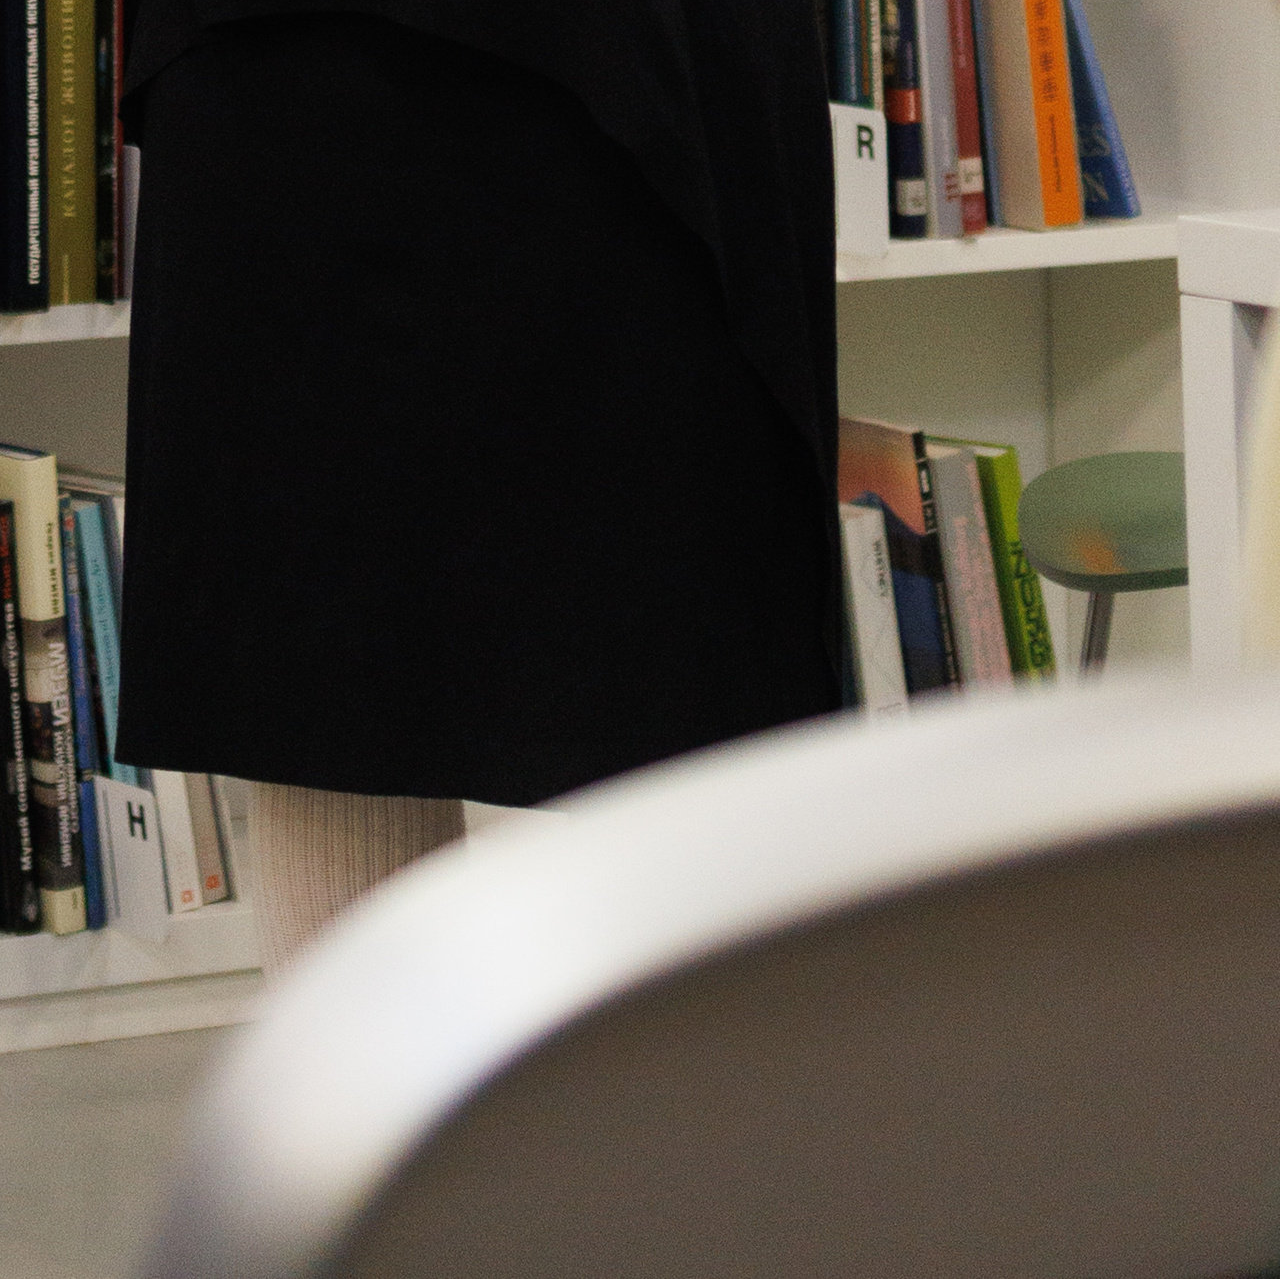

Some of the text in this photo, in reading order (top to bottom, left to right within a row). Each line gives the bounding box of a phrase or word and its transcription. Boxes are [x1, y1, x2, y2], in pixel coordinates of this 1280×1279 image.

[26, 27, 39, 137] ИЗОБРАЗИТЕЛЬНЫХ
[27, 138, 39, 176] МУЗЕЙ
[60, 115, 76, 220] КАТАЛОГ
[856, 123, 874, 162] R
[27, 178, 40, 286] ГОСУДАРСТВЕННЫЙ
[3, 602, 34, 872] Музей современного искусства
[125, 802, 143, 837] H
